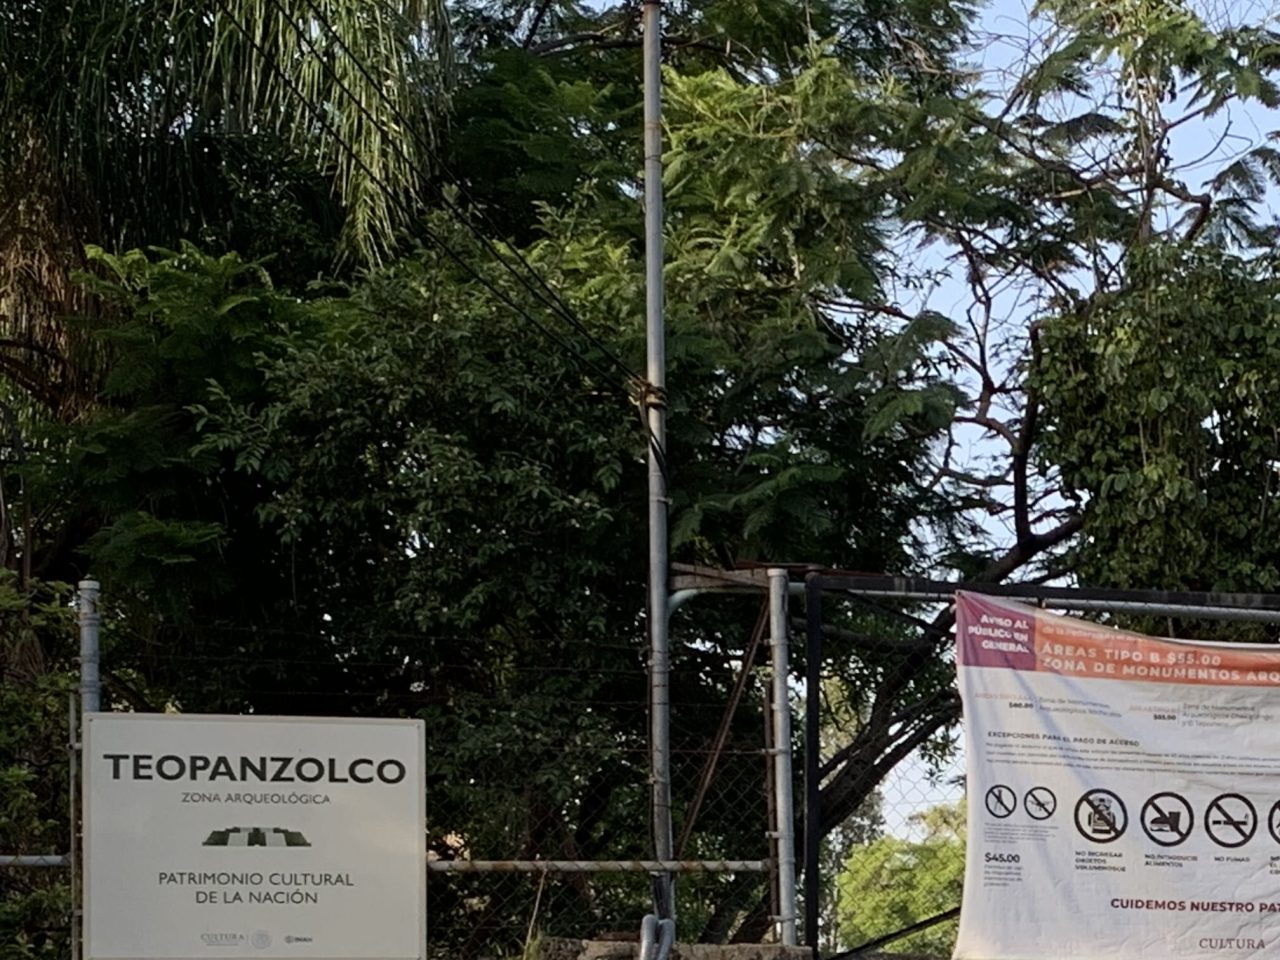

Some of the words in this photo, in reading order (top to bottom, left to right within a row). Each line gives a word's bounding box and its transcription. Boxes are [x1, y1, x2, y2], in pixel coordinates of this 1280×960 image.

[1041, 643, 1097, 658] ÁREAS
[1104, 648, 1143, 662] TIPO
[1149, 651, 1161, 663] B
[1166, 651, 1222, 666] $55.00
[1043, 656, 1087, 673] ZONA
[1093, 662, 1116, 674] DE
[1122, 664, 1241, 681] MONUMENTOS
[103, 754, 406, 784] TEOPANZOLCO
[181, 792, 222, 804] ZONA
[225, 791, 331, 805] ARQUEOLÓGICA
[984, 852, 1020, 863] $45.00
[158, 872, 264, 886] PATRIMONIO
[269, 873, 354, 887] CULTURAL
[195, 891, 217, 904] DE
[223, 892, 244, 904] LA
[249, 889, 318, 905] NACIÓN
[1110, 898, 1186, 911] CUIDEMOS
[1190, 900, 1255, 912] NUESTRO
[1199, 938, 1266, 949] CULTURA
